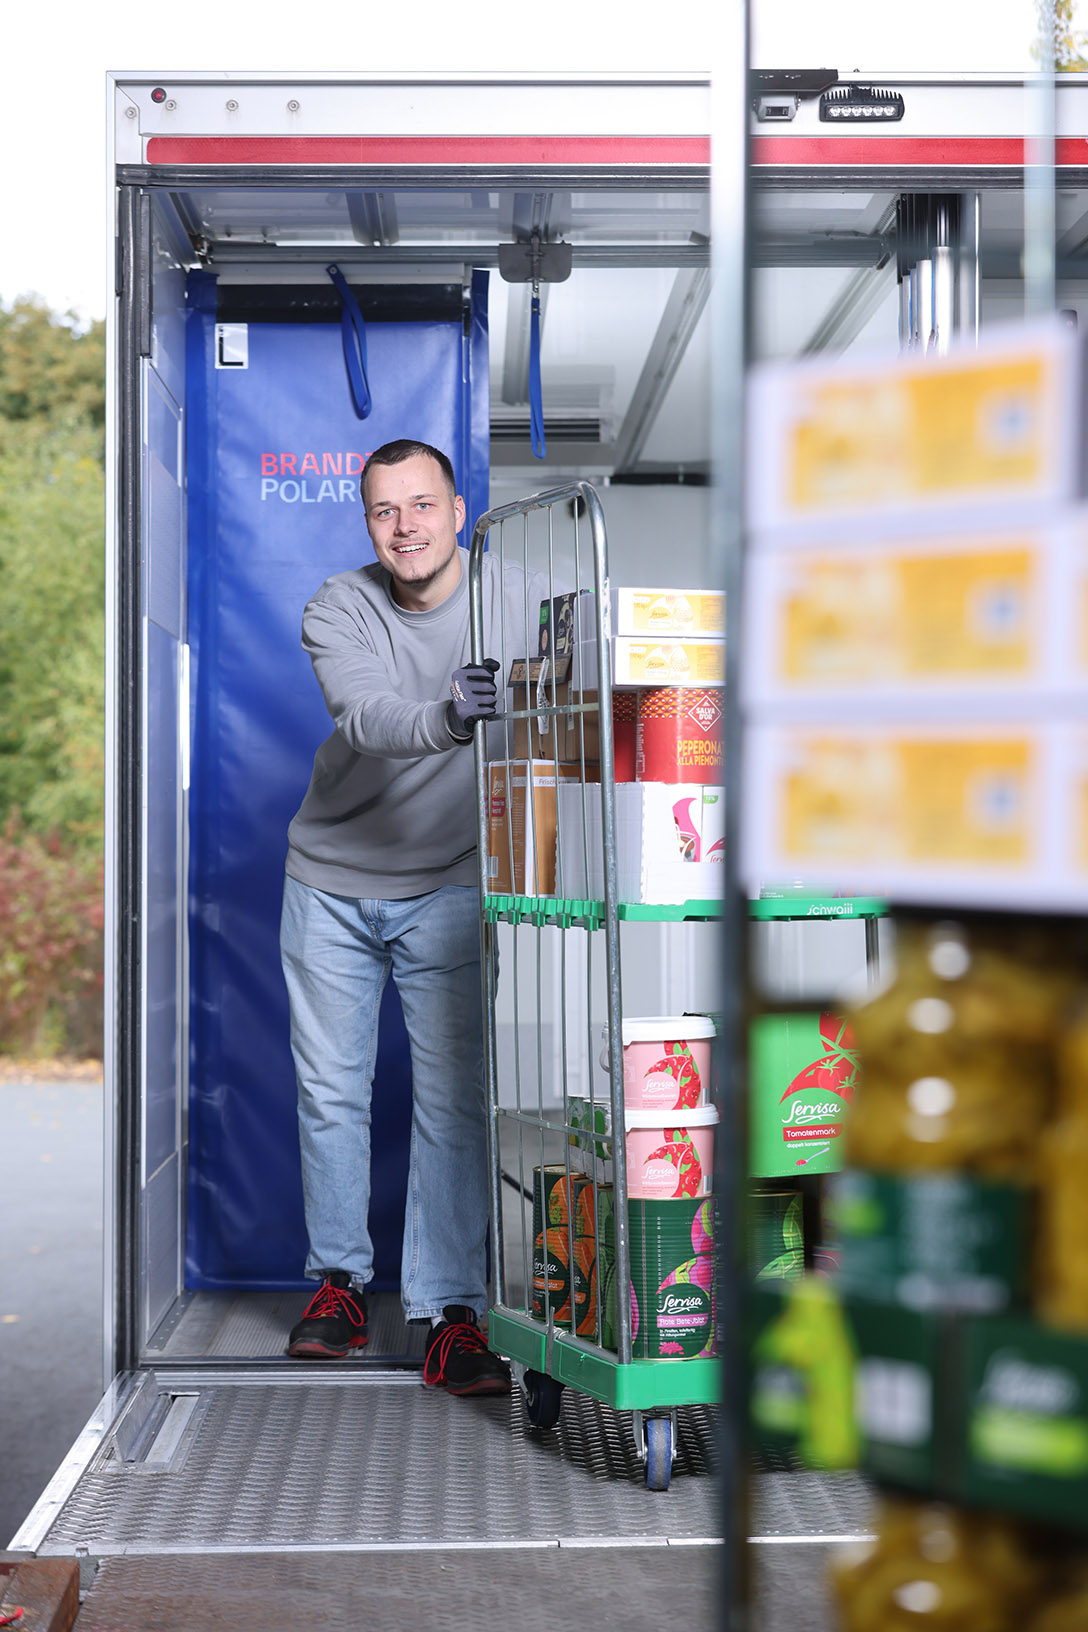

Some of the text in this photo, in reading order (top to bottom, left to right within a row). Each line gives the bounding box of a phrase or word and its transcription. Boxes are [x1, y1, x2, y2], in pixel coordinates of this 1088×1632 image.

[261, 452, 373, 476] BRAND
[695, 707, 716, 715] SALVA
[641, 1078, 676, 1093] Servisa
[781, 1099, 841, 1124] Servisa
[786, 1127, 836, 1138] Tomatenmark
[641, 1165, 675, 1180] Servisa
[656, 1294, 703, 1314] Servisa
